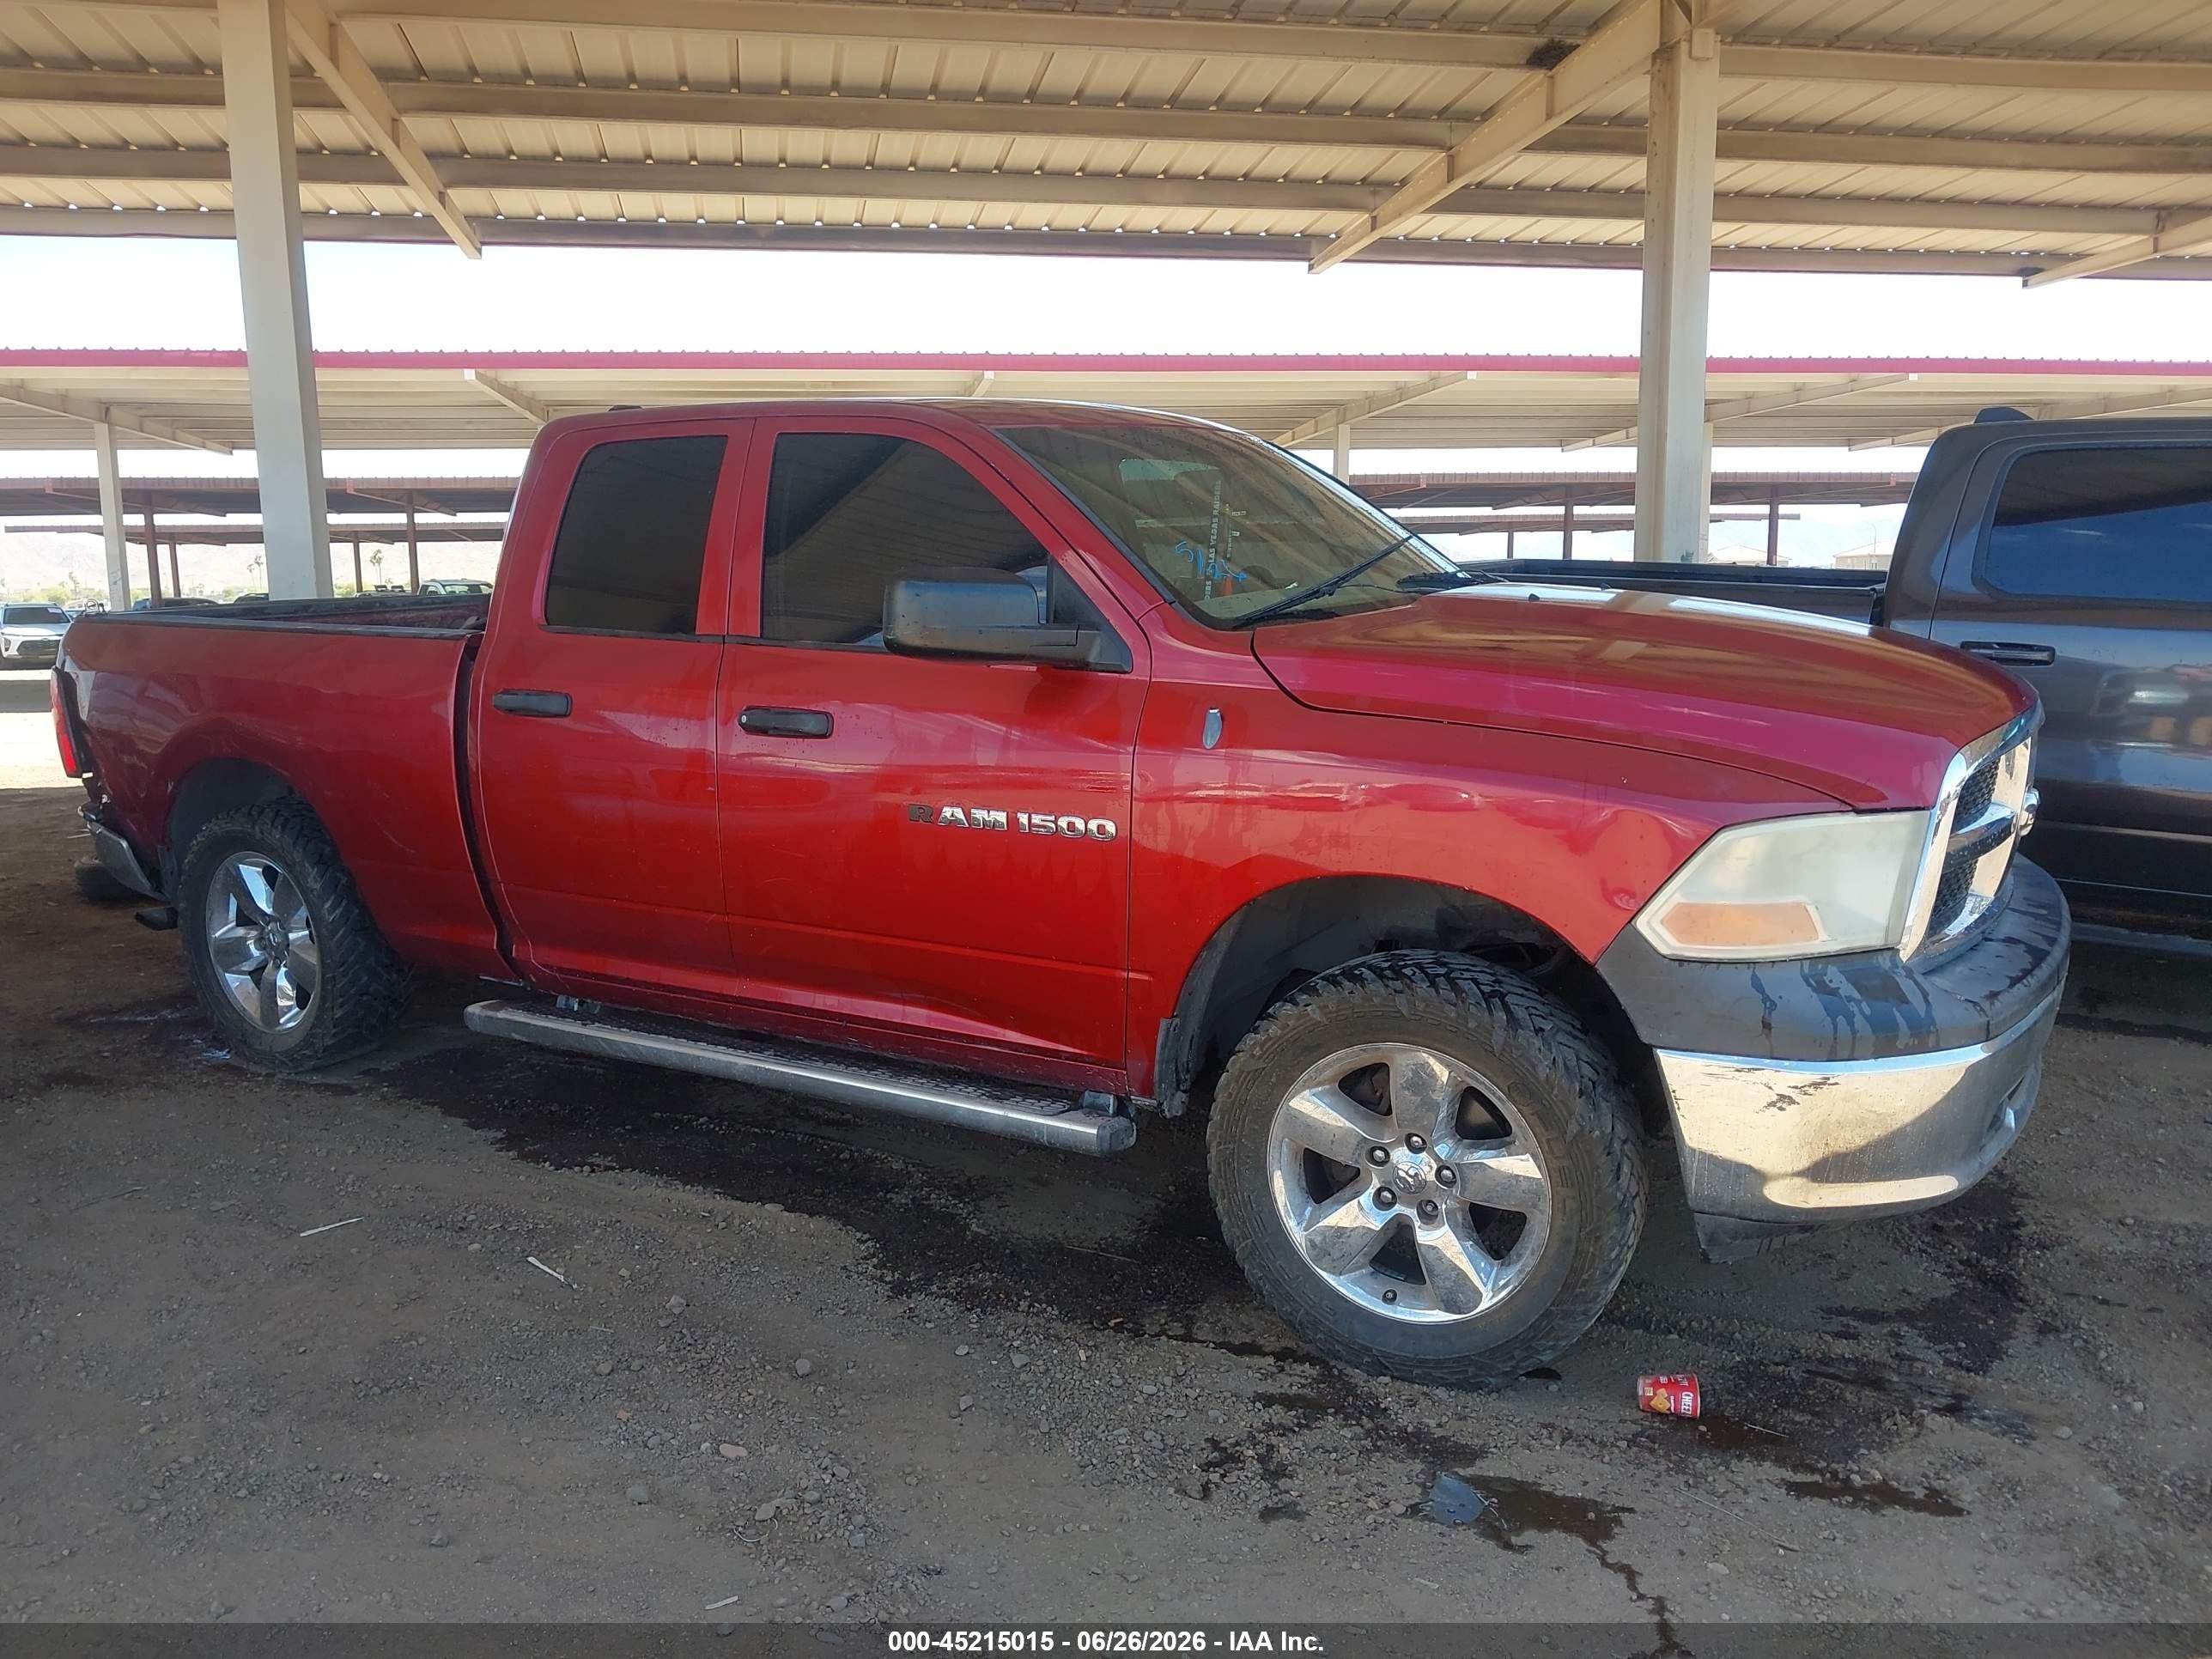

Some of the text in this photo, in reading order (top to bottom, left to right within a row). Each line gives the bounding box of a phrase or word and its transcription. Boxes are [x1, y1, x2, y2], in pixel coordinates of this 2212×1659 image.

[1210, 517, 1218, 546] VEGAS
[908, 803, 1118, 842] RAM 1500
